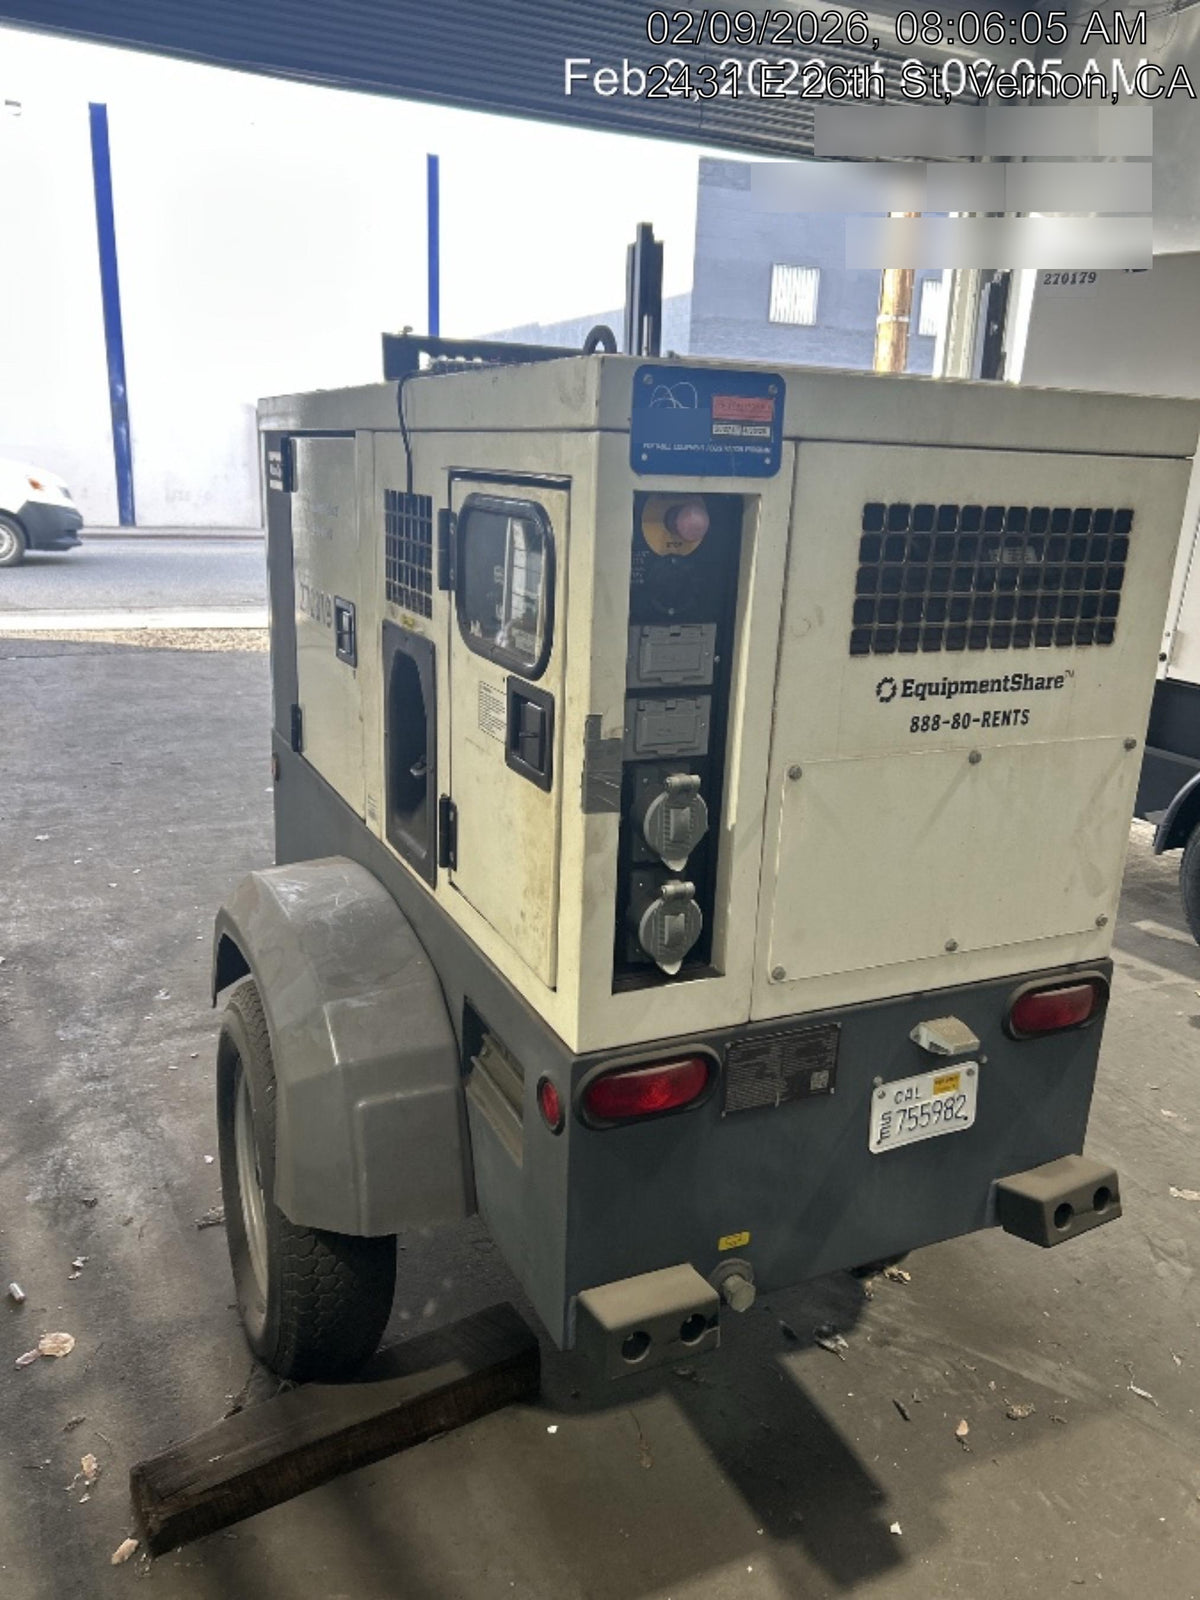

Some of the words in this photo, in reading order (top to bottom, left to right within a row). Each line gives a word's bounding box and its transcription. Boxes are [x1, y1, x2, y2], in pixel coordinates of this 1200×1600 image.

[1043, 271, 1097, 286] 270179
[901, 672, 1065, 701] EquipmentShare
[909, 708, 1030, 733] 888-80-RENTS
[894, 1087, 922, 1105] CAL
[895, 1094, 967, 1135] 755982
